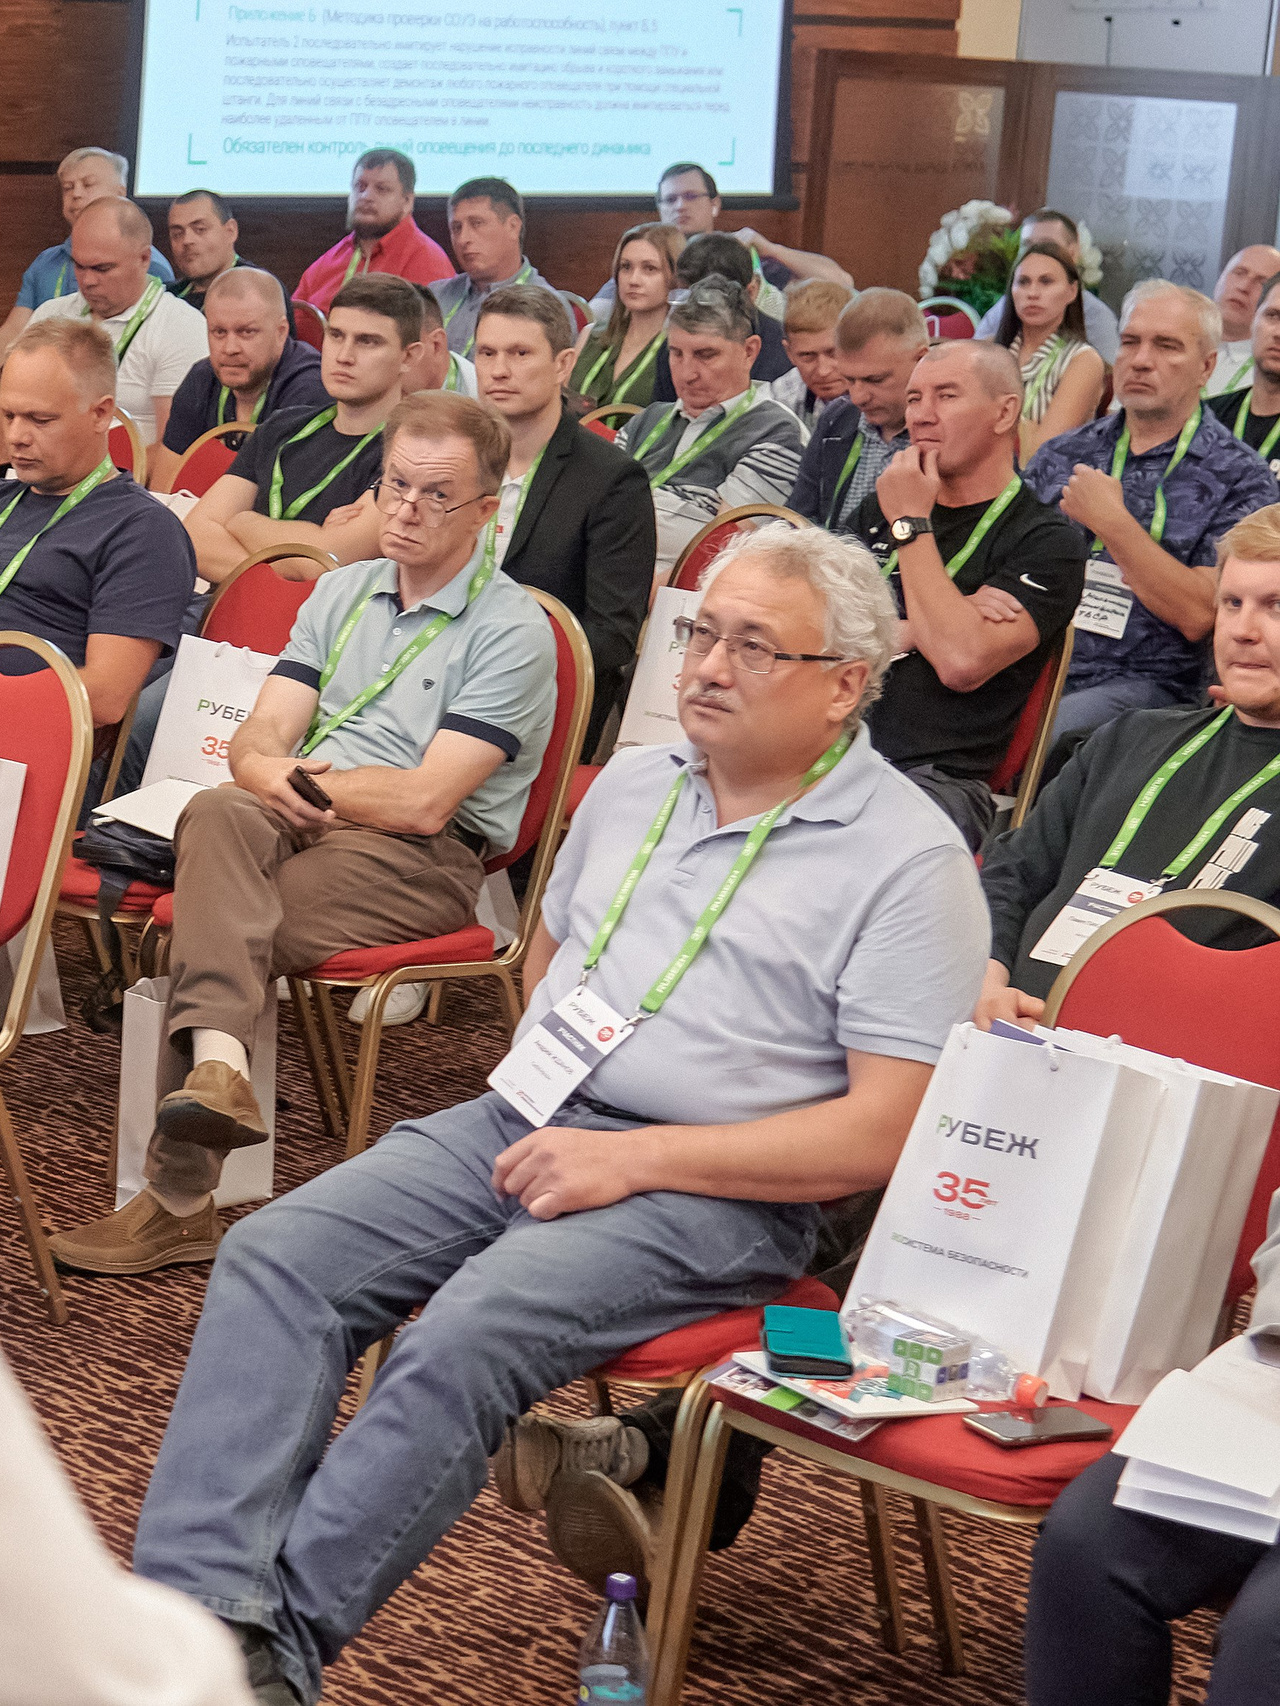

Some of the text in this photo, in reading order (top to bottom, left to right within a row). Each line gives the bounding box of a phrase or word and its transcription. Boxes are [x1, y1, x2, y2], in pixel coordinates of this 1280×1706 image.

[223, 137, 304, 152] Обязателен
[196, 698, 251, 723] РУБЕ
[201, 736, 230, 759] 35
[656, 954, 689, 993] RUBEZH
[710, 870, 740, 911] RUBEZH
[936, 1114, 1040, 1159] РУБЕЖ
[933, 1171, 991, 1209] 35
[947, 1249, 1029, 1278] БЕЗОПАСНОСТИ
